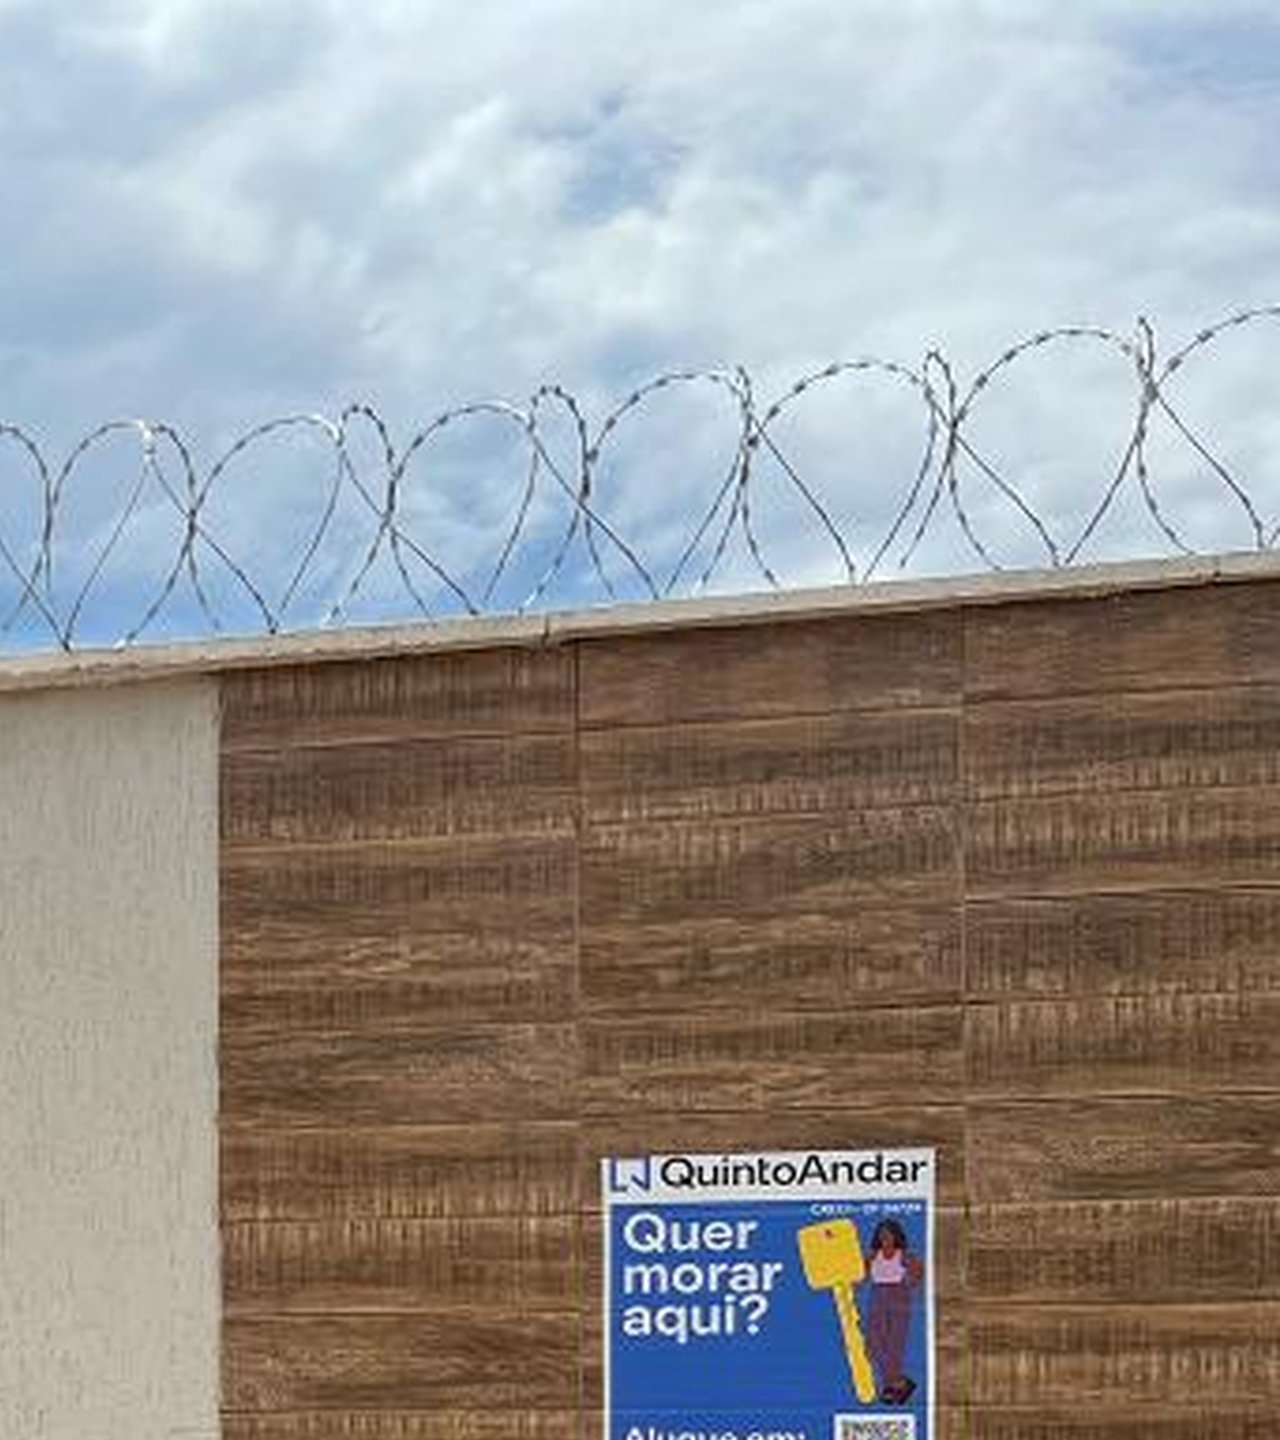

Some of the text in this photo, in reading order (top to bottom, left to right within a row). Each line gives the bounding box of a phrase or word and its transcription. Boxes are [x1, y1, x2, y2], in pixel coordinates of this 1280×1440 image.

[660, 1154, 928, 1188] QuintoAndar
[623, 1212, 758, 1253] Quer
[623, 1260, 783, 1294] morar
[623, 1294, 769, 1344] aqui?
